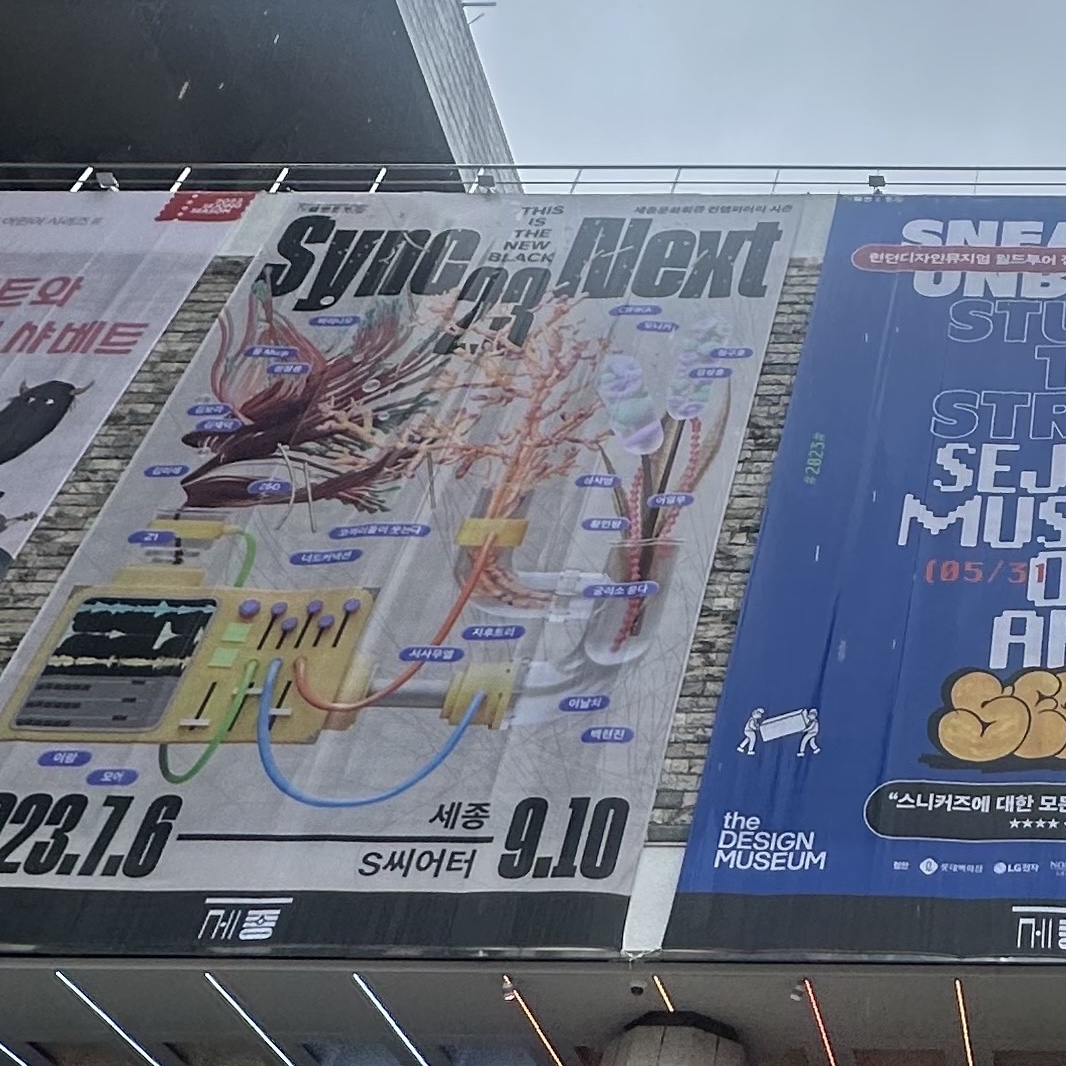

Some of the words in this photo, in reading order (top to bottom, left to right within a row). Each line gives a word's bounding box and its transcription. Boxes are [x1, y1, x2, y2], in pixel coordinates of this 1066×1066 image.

[521, 206, 564, 215] THIS
[528, 218, 546, 227] IS
[514, 229, 552, 239] THE
[503, 240, 552, 250] NEW
[253, 215, 481, 311] Sync
[553, 217, 783, 299] Next
[487, 252, 556, 263] BLACK
[568, 698, 602, 709] 이날치
[996, 795, 1035, 813] 대한
[428, 802, 491, 830] 세종
[724, 811, 760, 830] the
[0, 793, 183, 878] 23.7.6
[497, 796, 630, 880] 9.10
[718, 830, 815, 851] DESIGN
[358, 849, 477, 879] S씨어터
[714, 850, 827, 871] MUSEUM
[1007, 863, 1040, 873] LG전자
